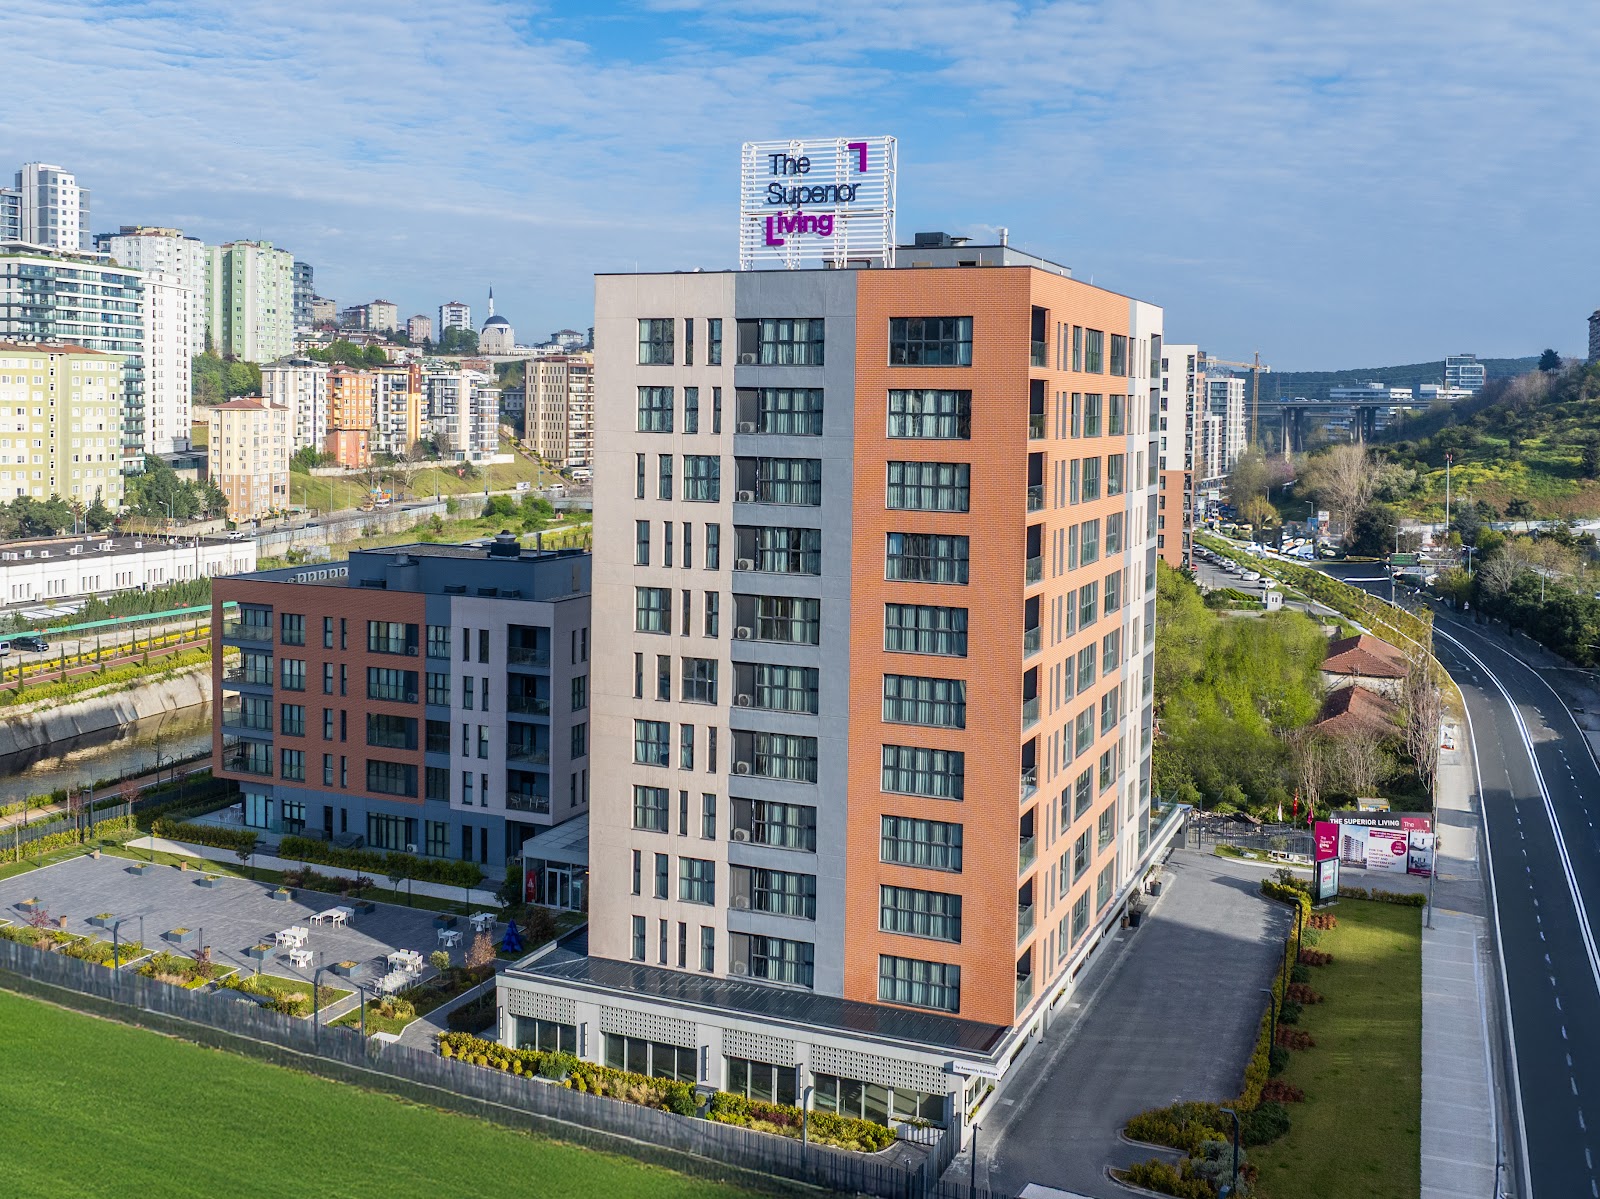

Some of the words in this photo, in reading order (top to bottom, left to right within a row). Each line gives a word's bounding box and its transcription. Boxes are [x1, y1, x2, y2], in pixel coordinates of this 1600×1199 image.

[768, 153, 811, 176] The
[767, 182, 862, 208] Superior
[766, 211, 835, 246] Living
